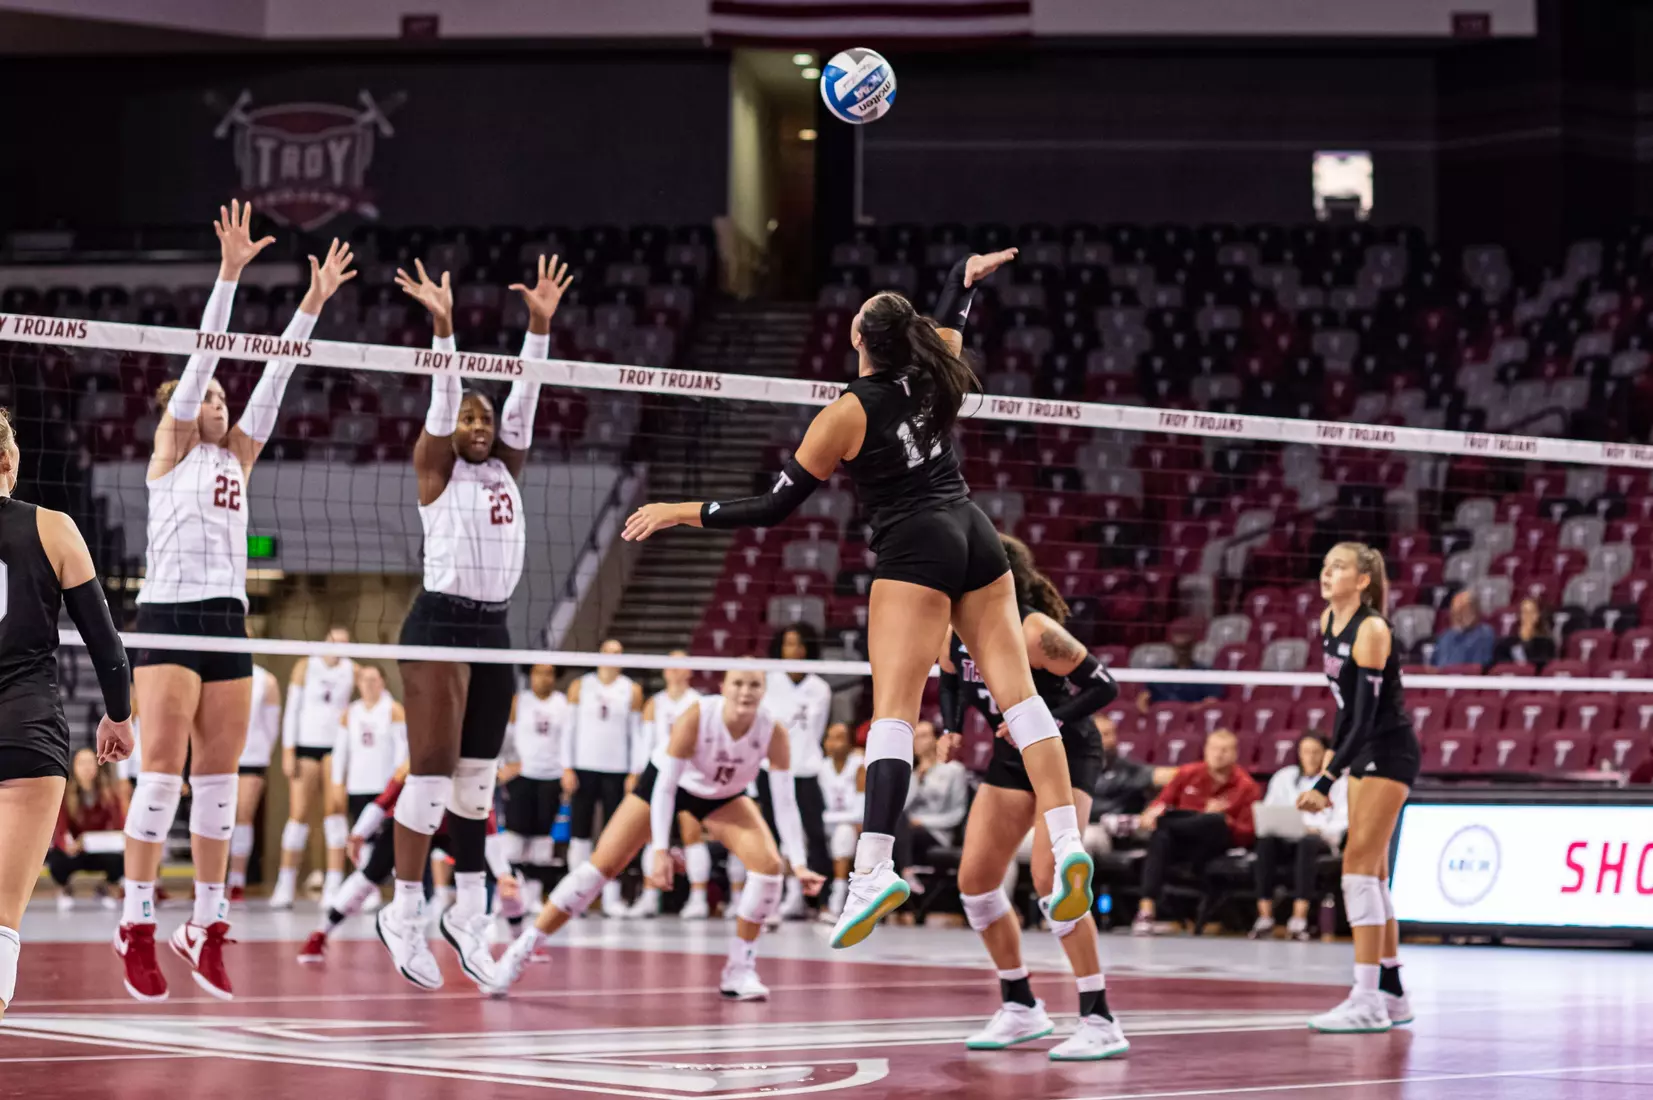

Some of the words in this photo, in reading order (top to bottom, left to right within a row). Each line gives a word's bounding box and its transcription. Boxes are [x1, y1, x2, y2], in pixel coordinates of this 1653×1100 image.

[858, 80, 892, 112] molten
[254, 137, 352, 189] TROY
[13, 317, 88, 340] TROJANS
[196, 332, 237, 351] TROY
[243, 336, 313, 358] TROJANS
[414, 350, 453, 369] TROY
[458, 354, 525, 376] TROJANS
[618, 368, 656, 386] TROY
[660, 371, 722, 391] TROJANS
[990, 399, 1022, 415] TROY
[1028, 401, 1082, 420] TROJANS
[1158, 412, 1190, 427] TROY
[1192, 415, 1244, 433] TROJANS
[1316, 424, 1345, 440] TROY
[1348, 427, 1396, 444] TROJANS
[213, 473, 241, 512] 22
[488, 492, 514, 526] 23
